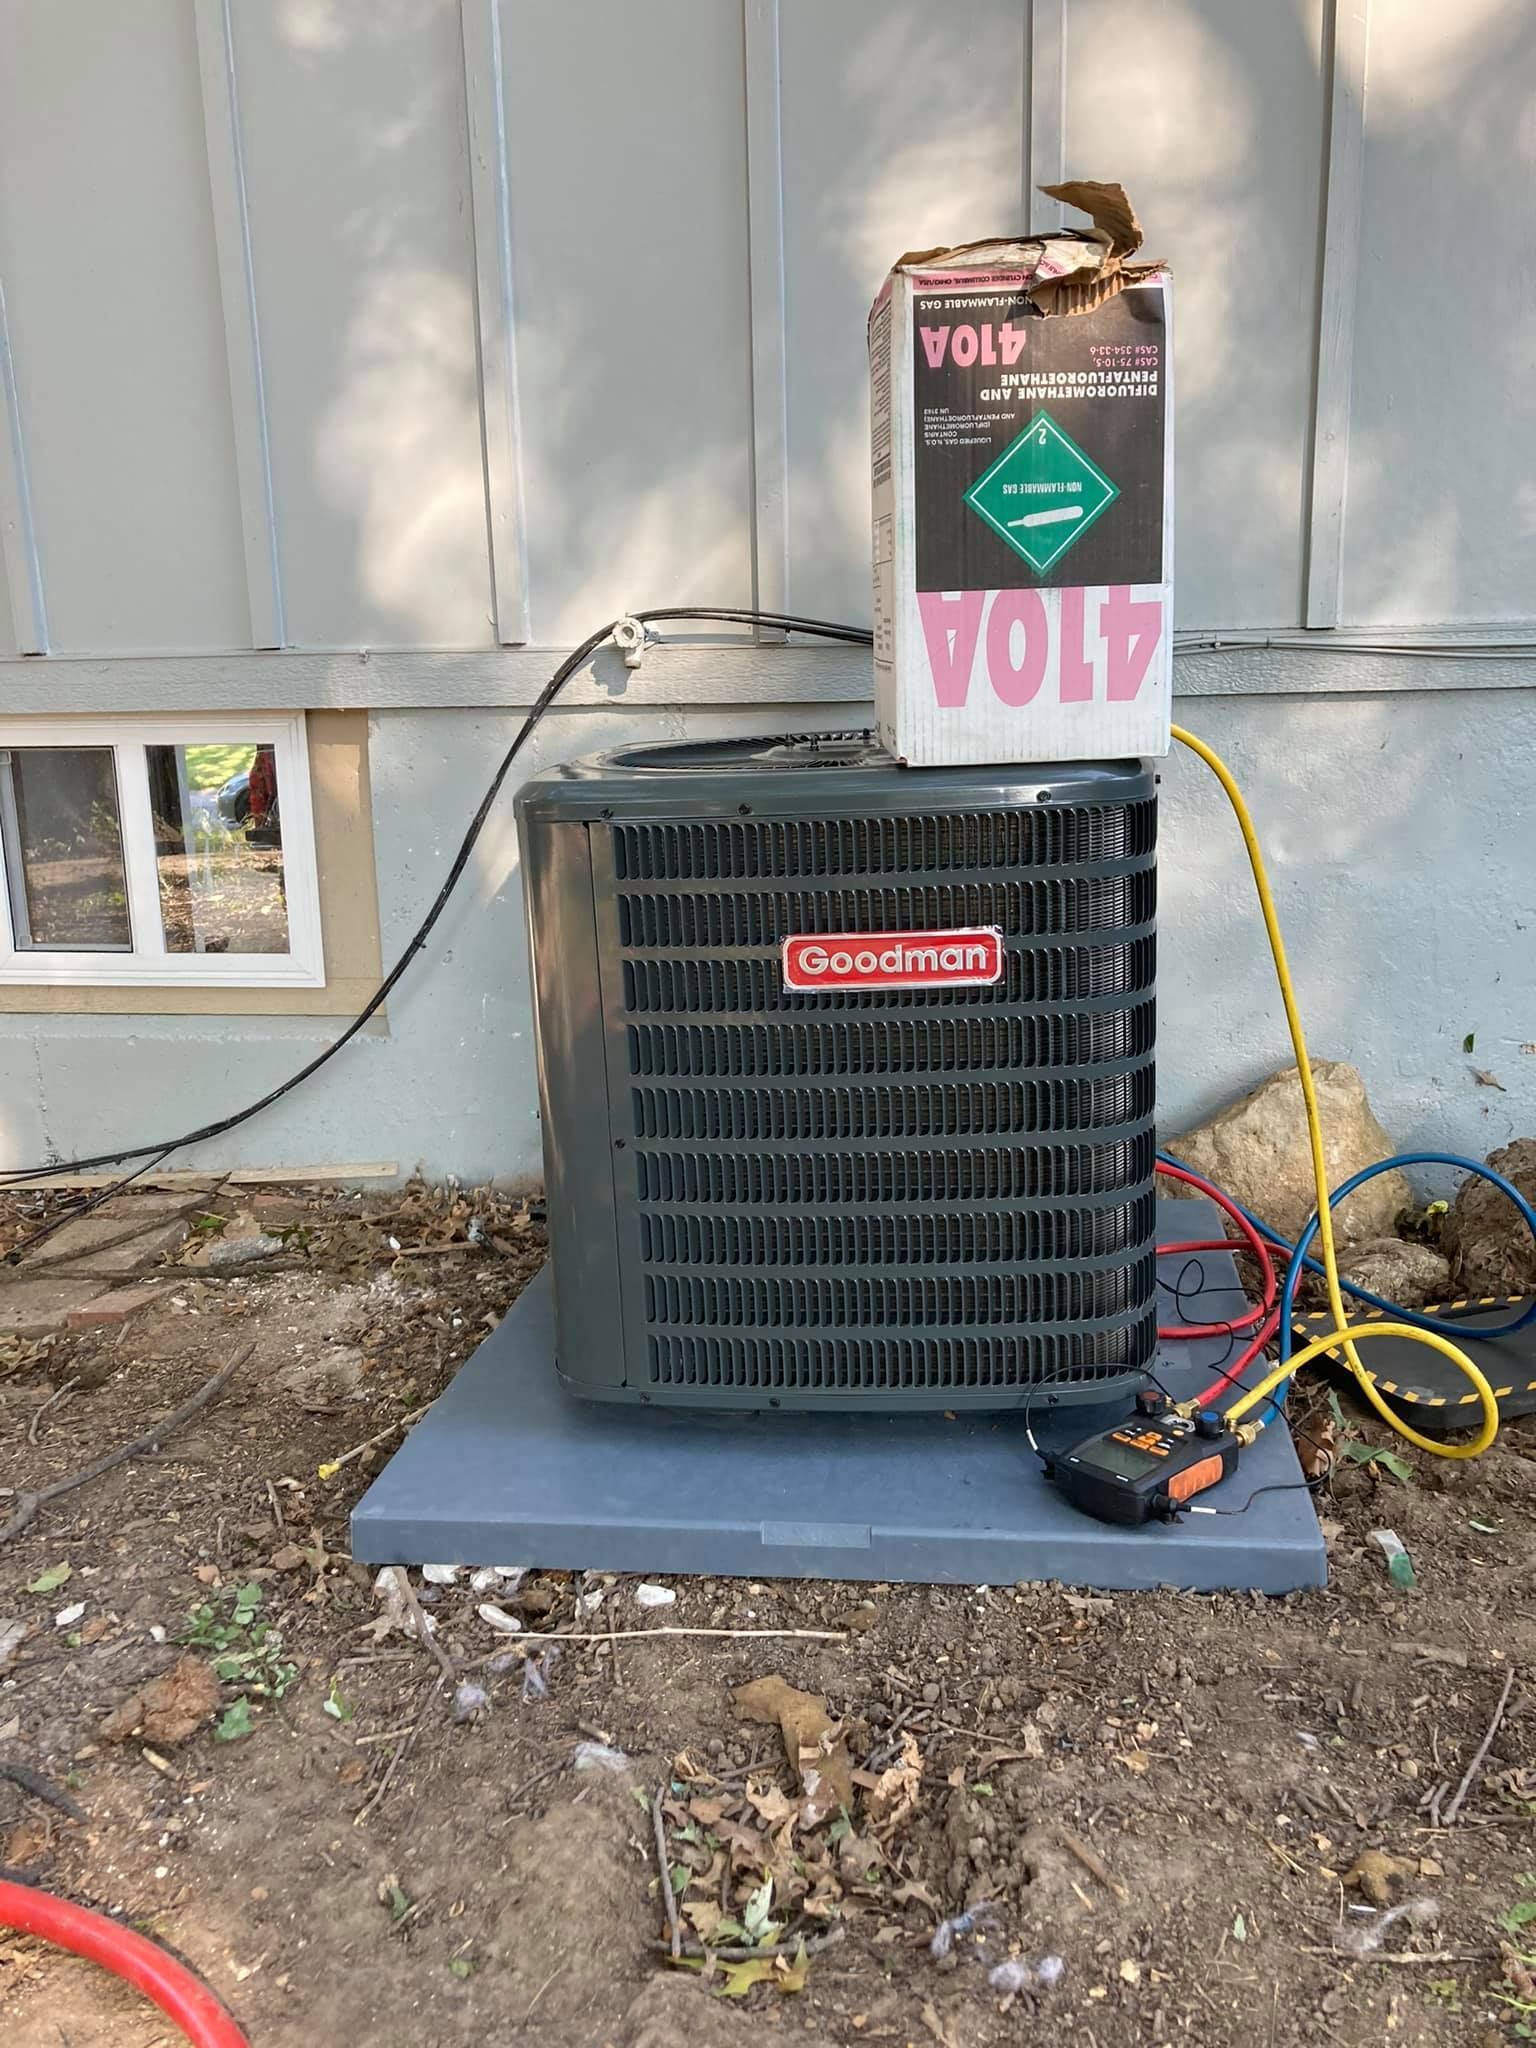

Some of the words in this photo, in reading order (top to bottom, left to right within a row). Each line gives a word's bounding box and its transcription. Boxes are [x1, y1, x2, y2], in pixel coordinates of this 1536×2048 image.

[920, 300, 942, 310] GAS
[945, 296, 1032, 309] NON-FLAMMABLE
[920, 323, 1026, 368] 410A
[1090, 346, 1132, 355] 354-33-6
[1135, 346, 1158, 354] CAS#
[1135, 358, 1158, 366] CAS#
[1001, 371, 1158, 386] PENTAFLUOROETHANE
[980, 387, 1012, 401] AND
[1018, 385, 1158, 399] DIFLUOROMETHANE
[1038, 428, 1047, 445] 2
[1002, 483, 1018, 494] GAS
[1019, 482, 1082, 494] NON-FLAMMABLE
[916, 585, 1162, 708] 410A
[799, 945, 987, 975] Goodman
